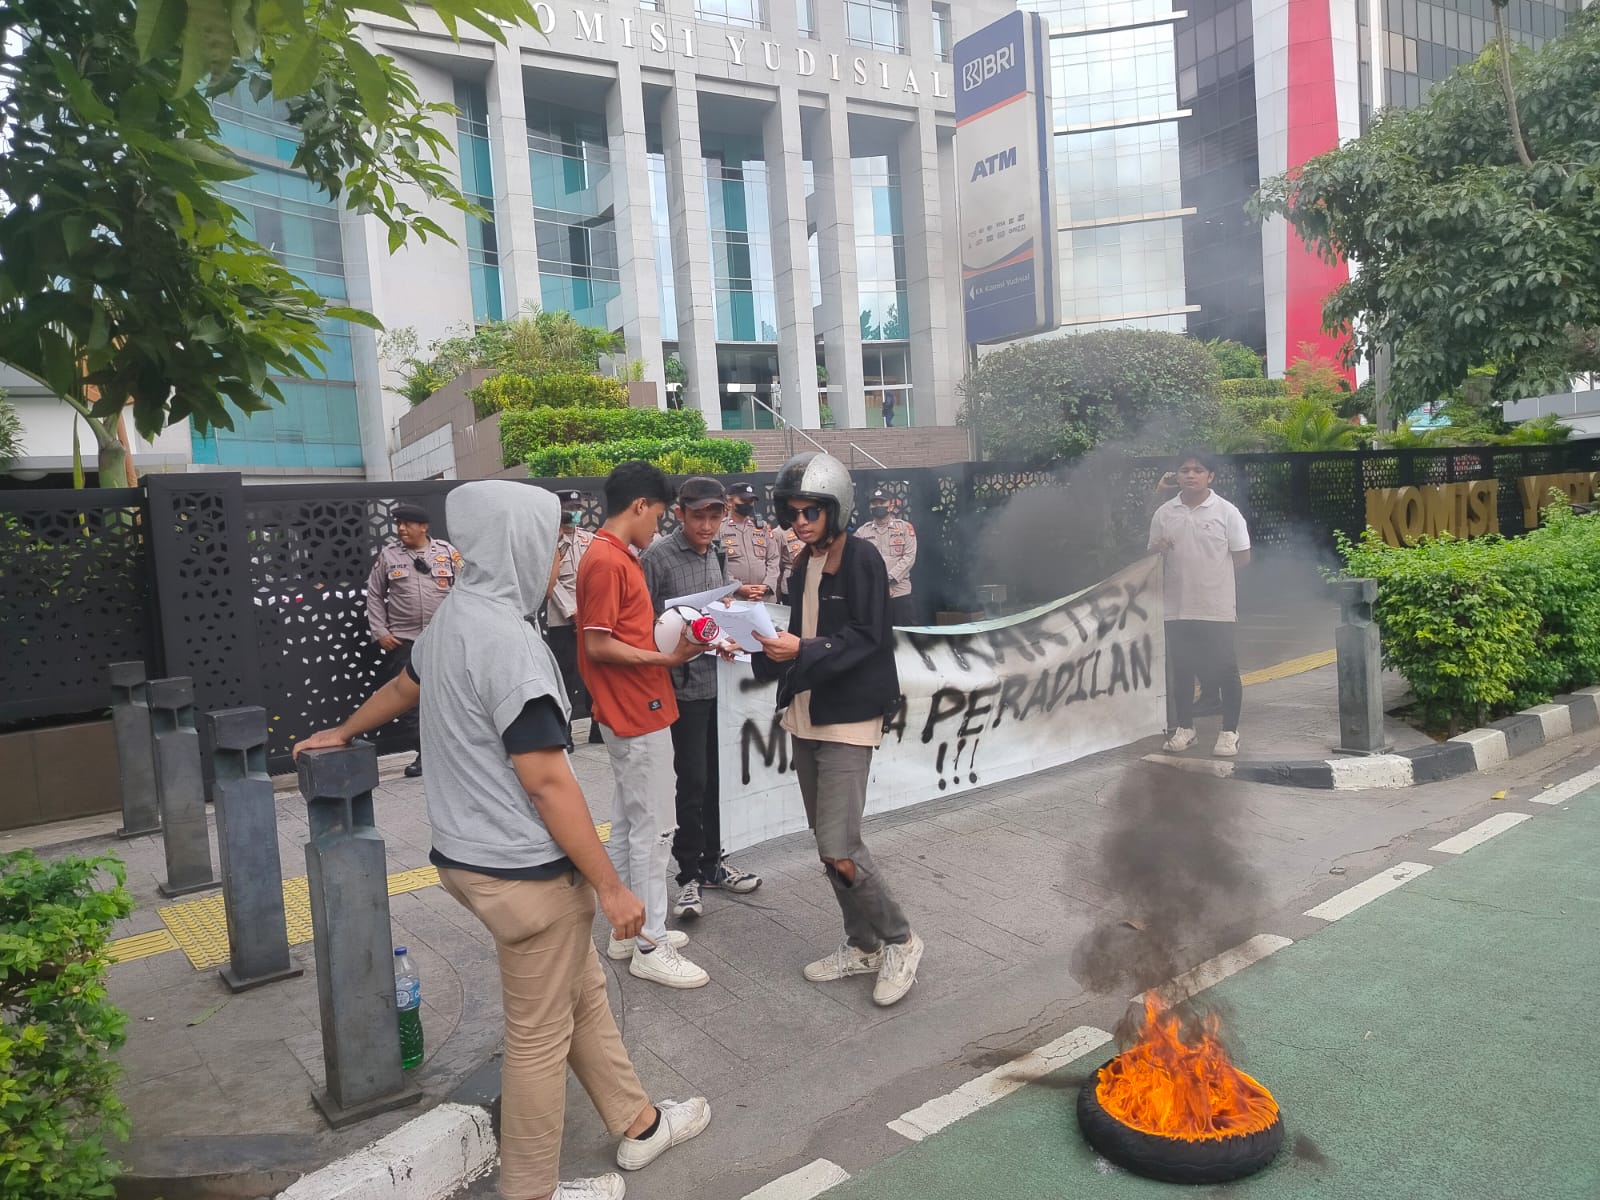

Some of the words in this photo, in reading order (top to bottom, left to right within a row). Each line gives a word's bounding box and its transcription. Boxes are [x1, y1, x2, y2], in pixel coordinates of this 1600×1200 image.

[487, 2, 696, 59] OMISI
[726, 34, 948, 98] YUDISIAL
[983, 42, 1015, 80] BRI
[970, 146, 1017, 183] ATM
[1366, 479, 1499, 548] KOMISI
[921, 633, 1152, 744] PERADILAN
